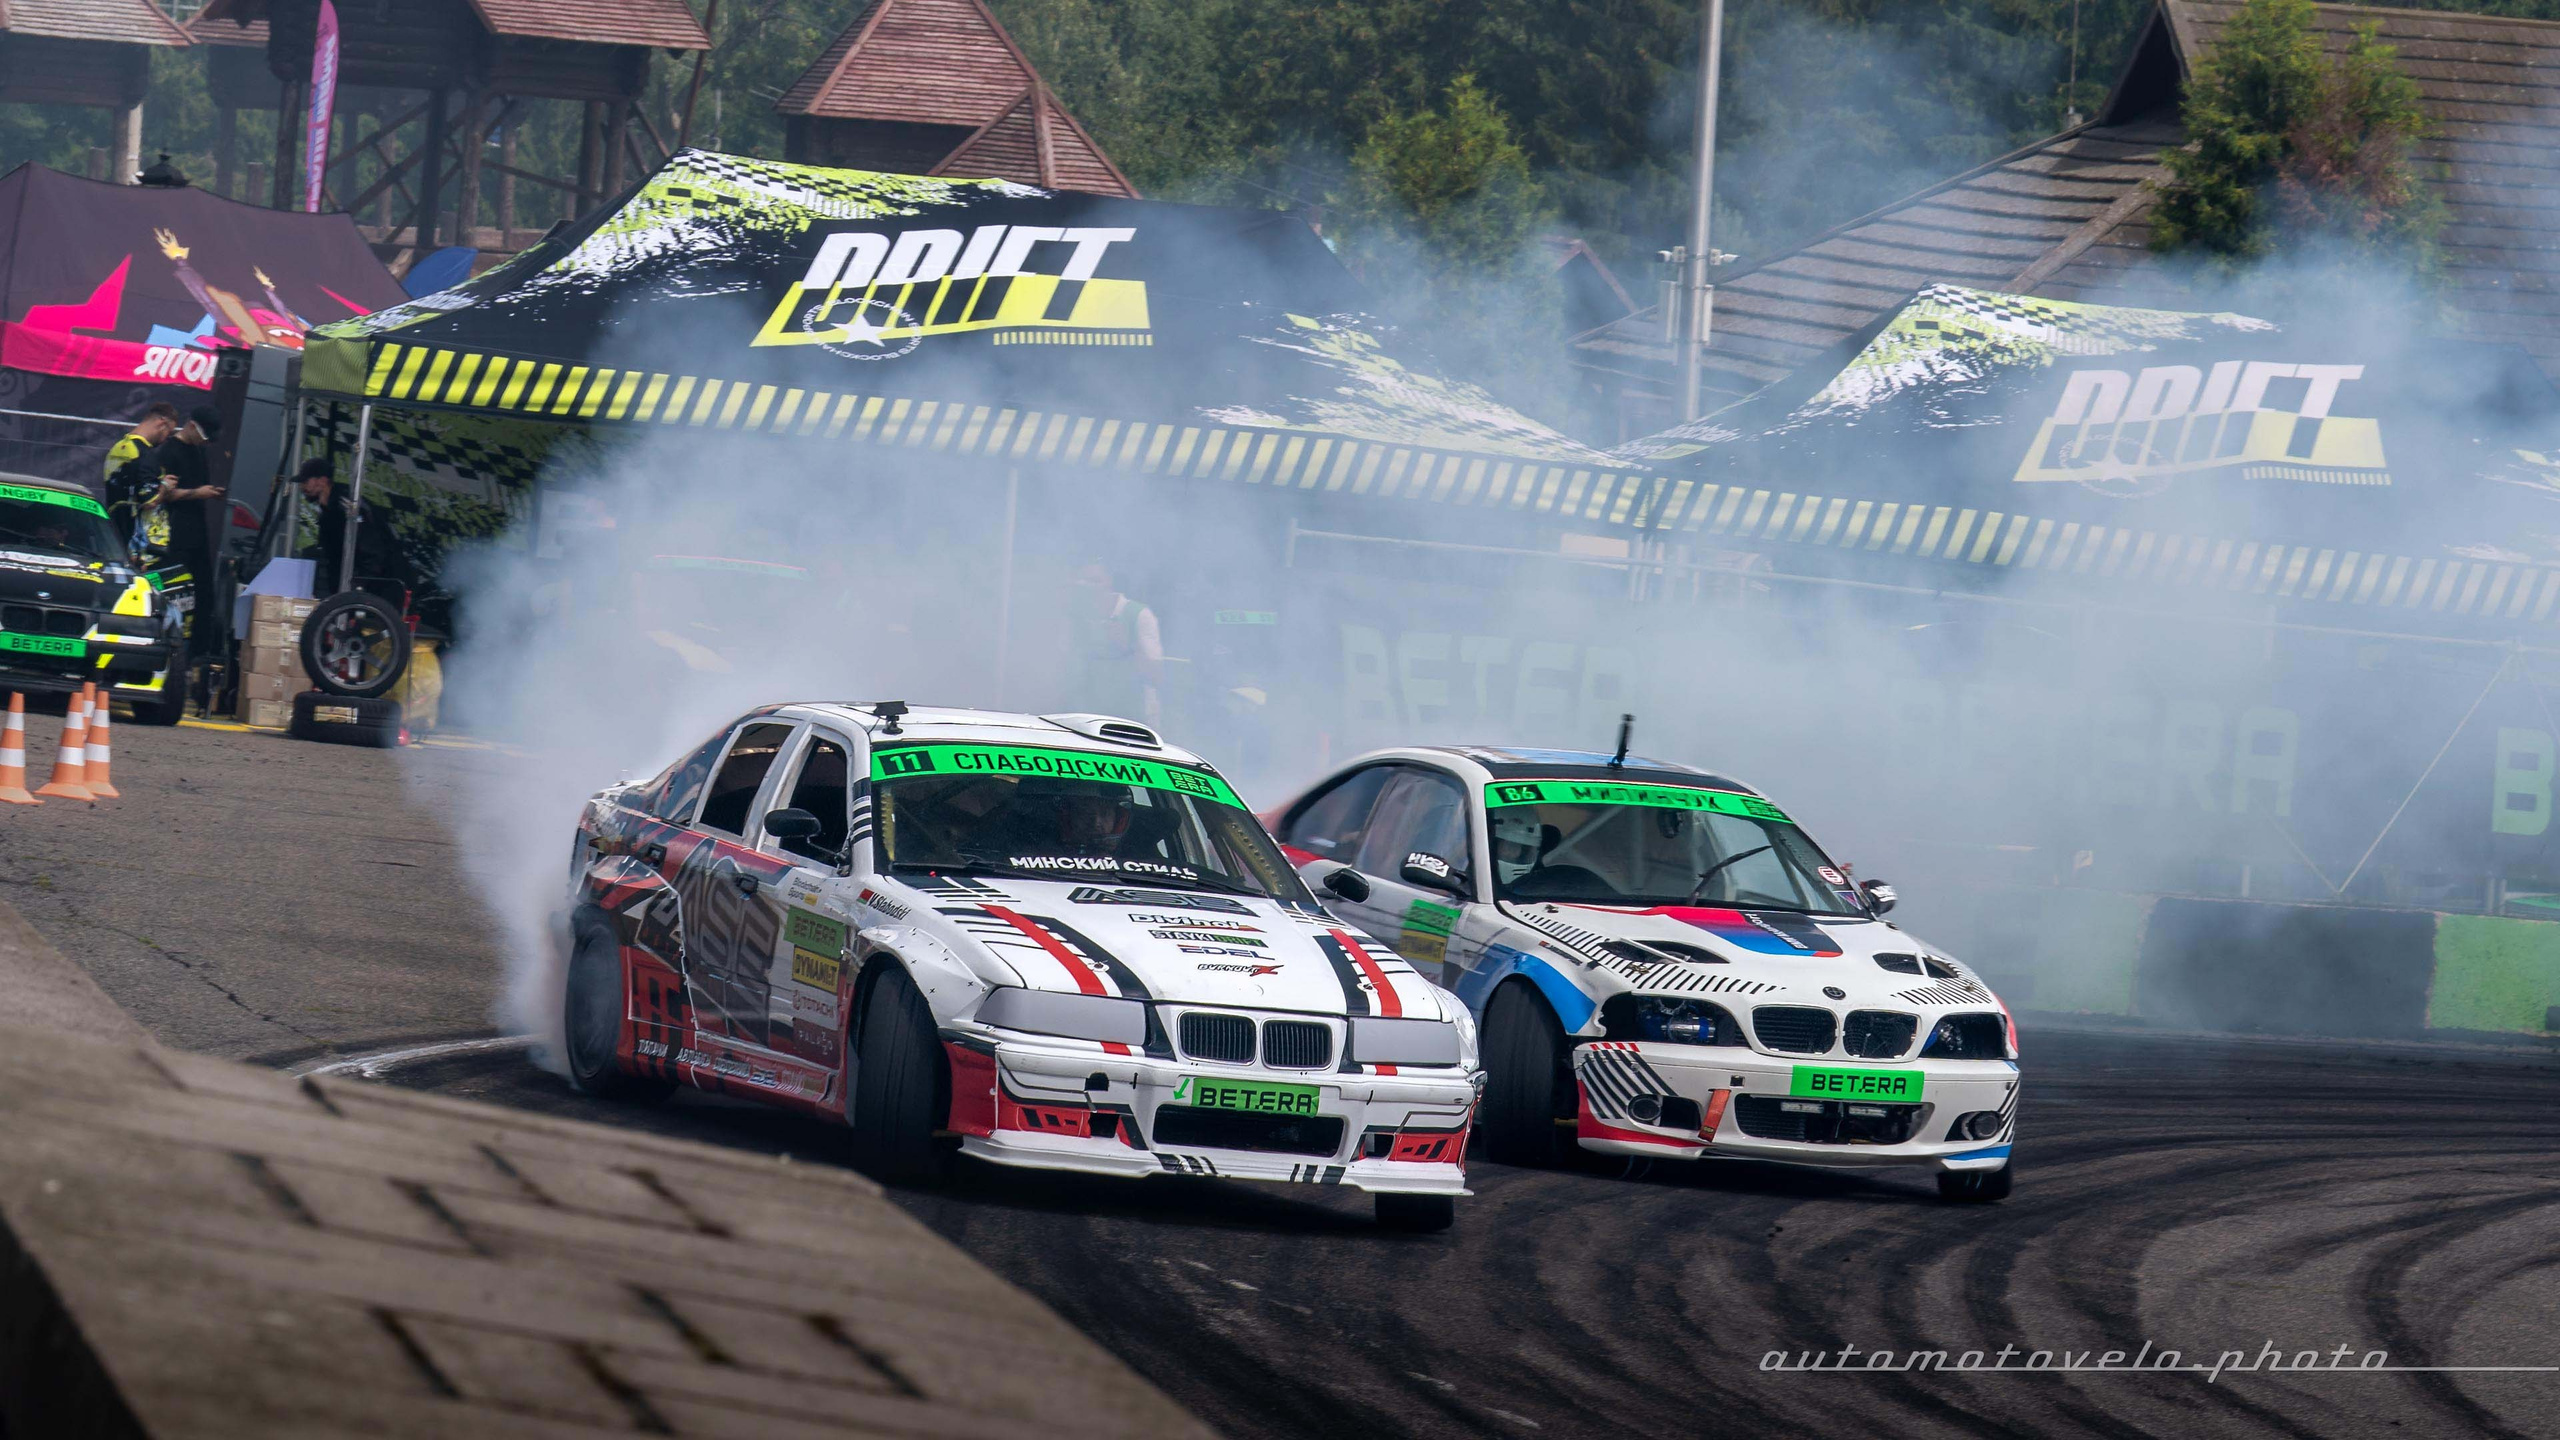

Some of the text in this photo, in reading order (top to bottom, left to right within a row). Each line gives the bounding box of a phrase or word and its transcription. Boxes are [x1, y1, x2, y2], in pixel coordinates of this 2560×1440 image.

[768, 225, 1138, 336] DRIFT
[2032, 360, 2368, 473] DRIFT
[11, 637, 74, 653] BETERA
[1341, 622, 1640, 735] BETER
[890, 753, 922, 772] 11
[954, 752, 1154, 784] СЛАБОДСКИЙ
[1505, 787, 1536, 801] 86
[1009, 856, 1198, 880] МИНСКИЙ СТИЛЬ
[793, 916, 837, 947] BETERA
[1128, 914, 1240, 930] Divinol
[1811, 1073, 1908, 1095] BETERA
[1198, 1086, 1313, 1113] BETERA
